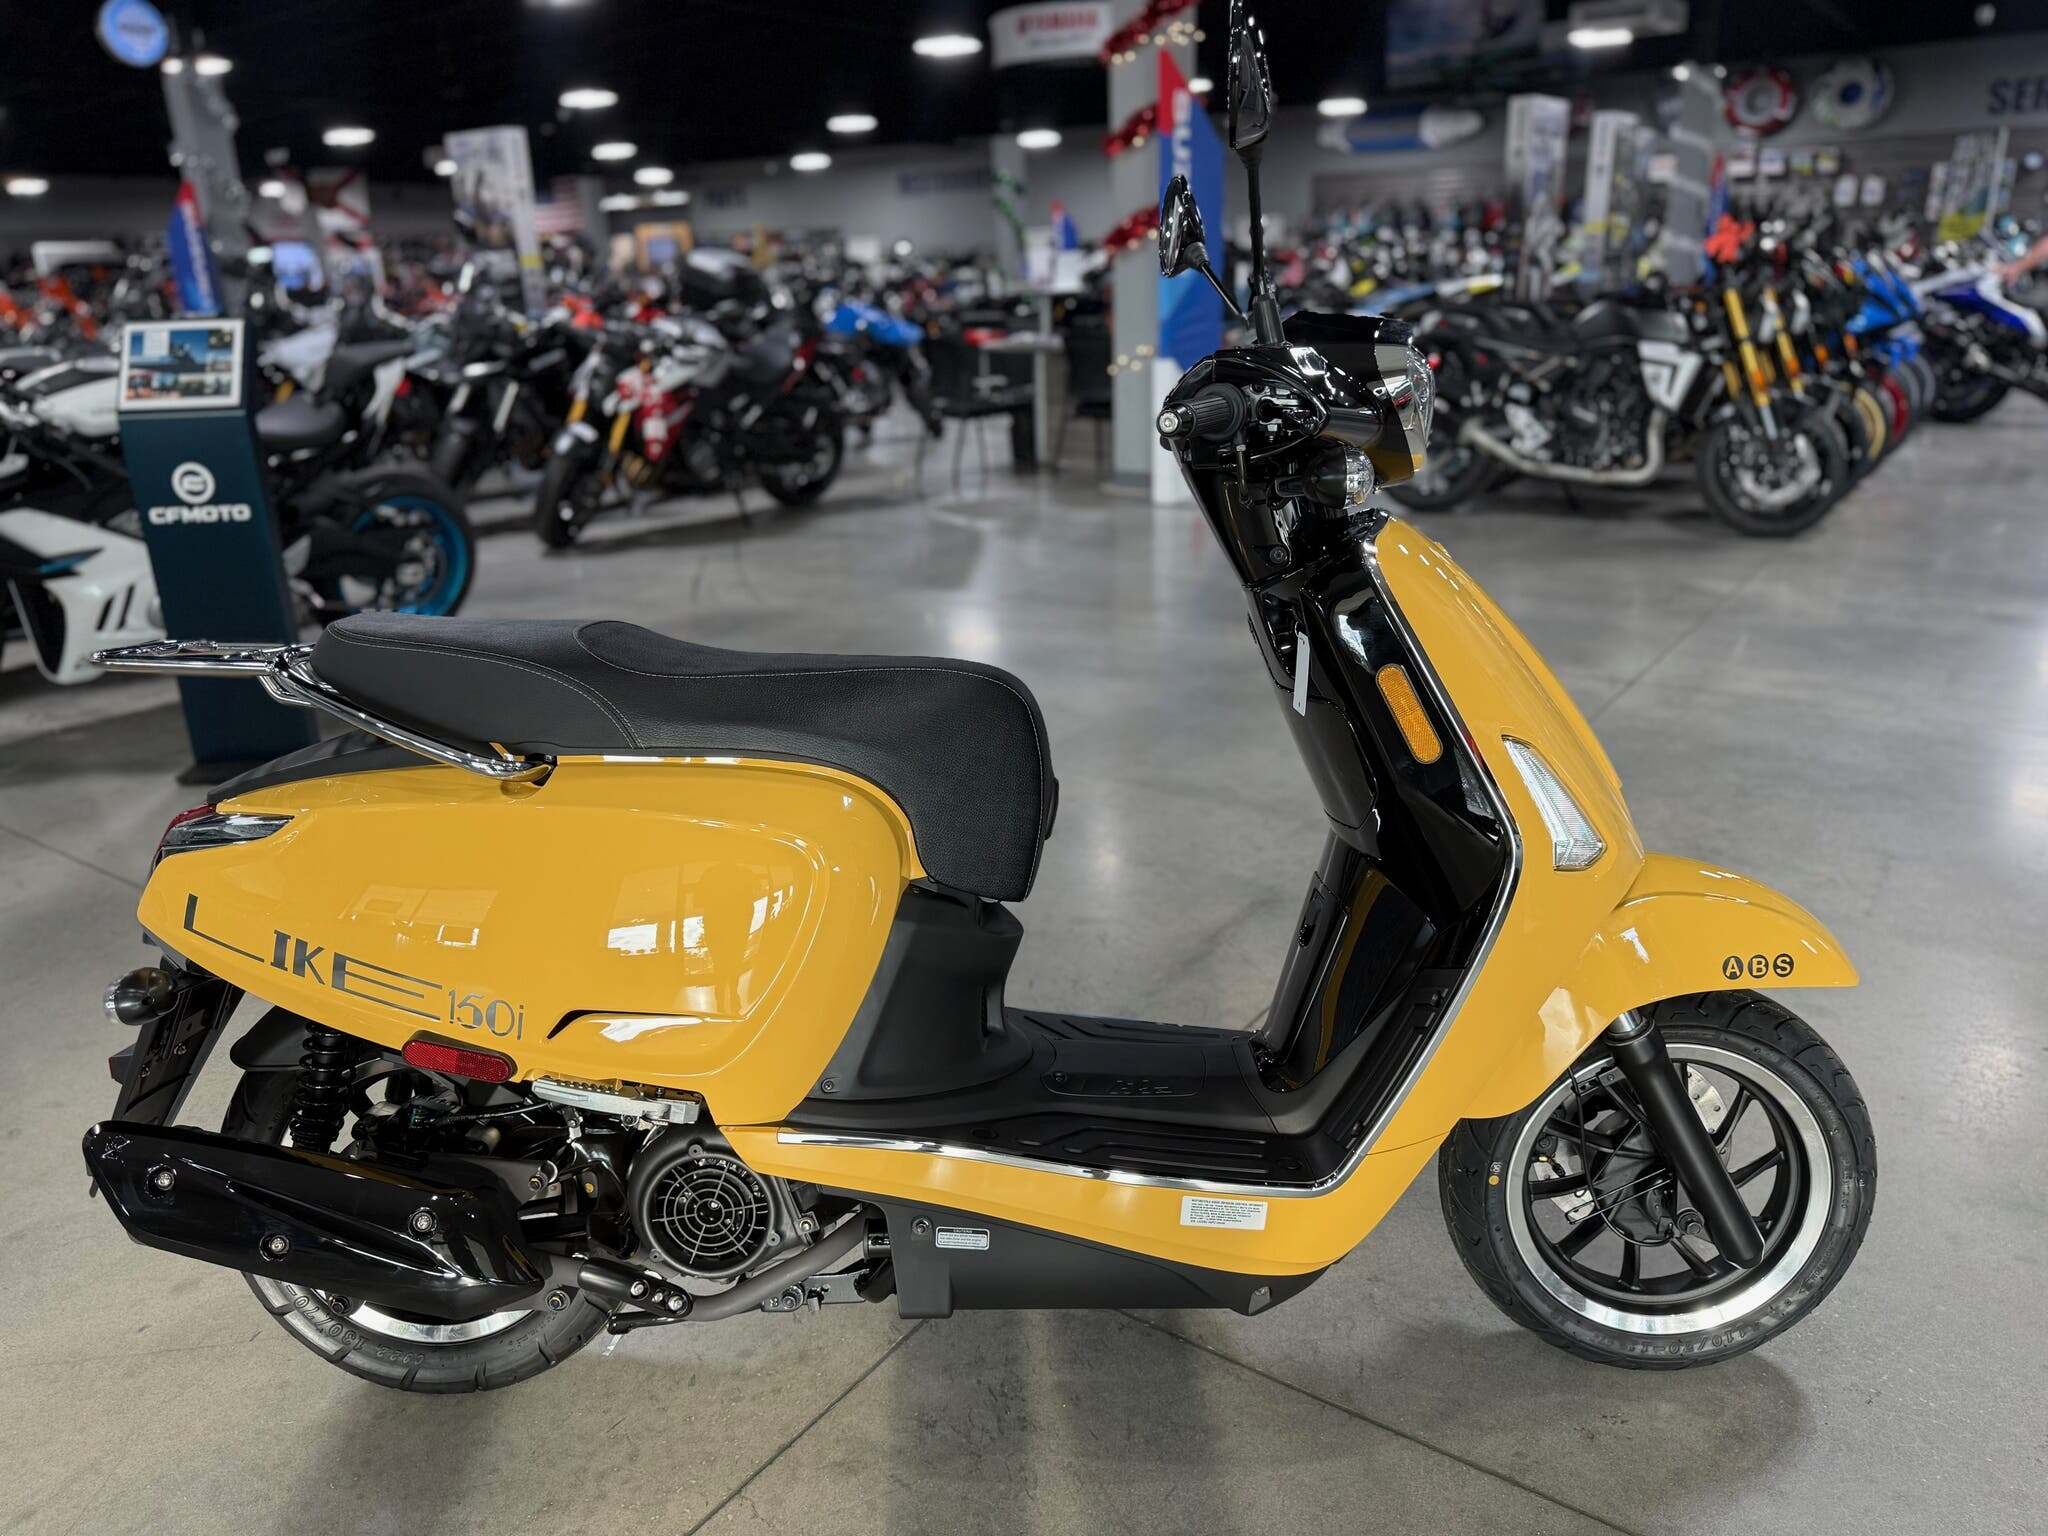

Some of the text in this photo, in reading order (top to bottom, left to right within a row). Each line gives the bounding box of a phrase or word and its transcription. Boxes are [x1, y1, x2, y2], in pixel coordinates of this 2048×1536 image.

[148, 503, 252, 525] CFMOTO
[184, 893, 525, 1041] LIKE 150i
[1723, 955, 1793, 978] ABS
